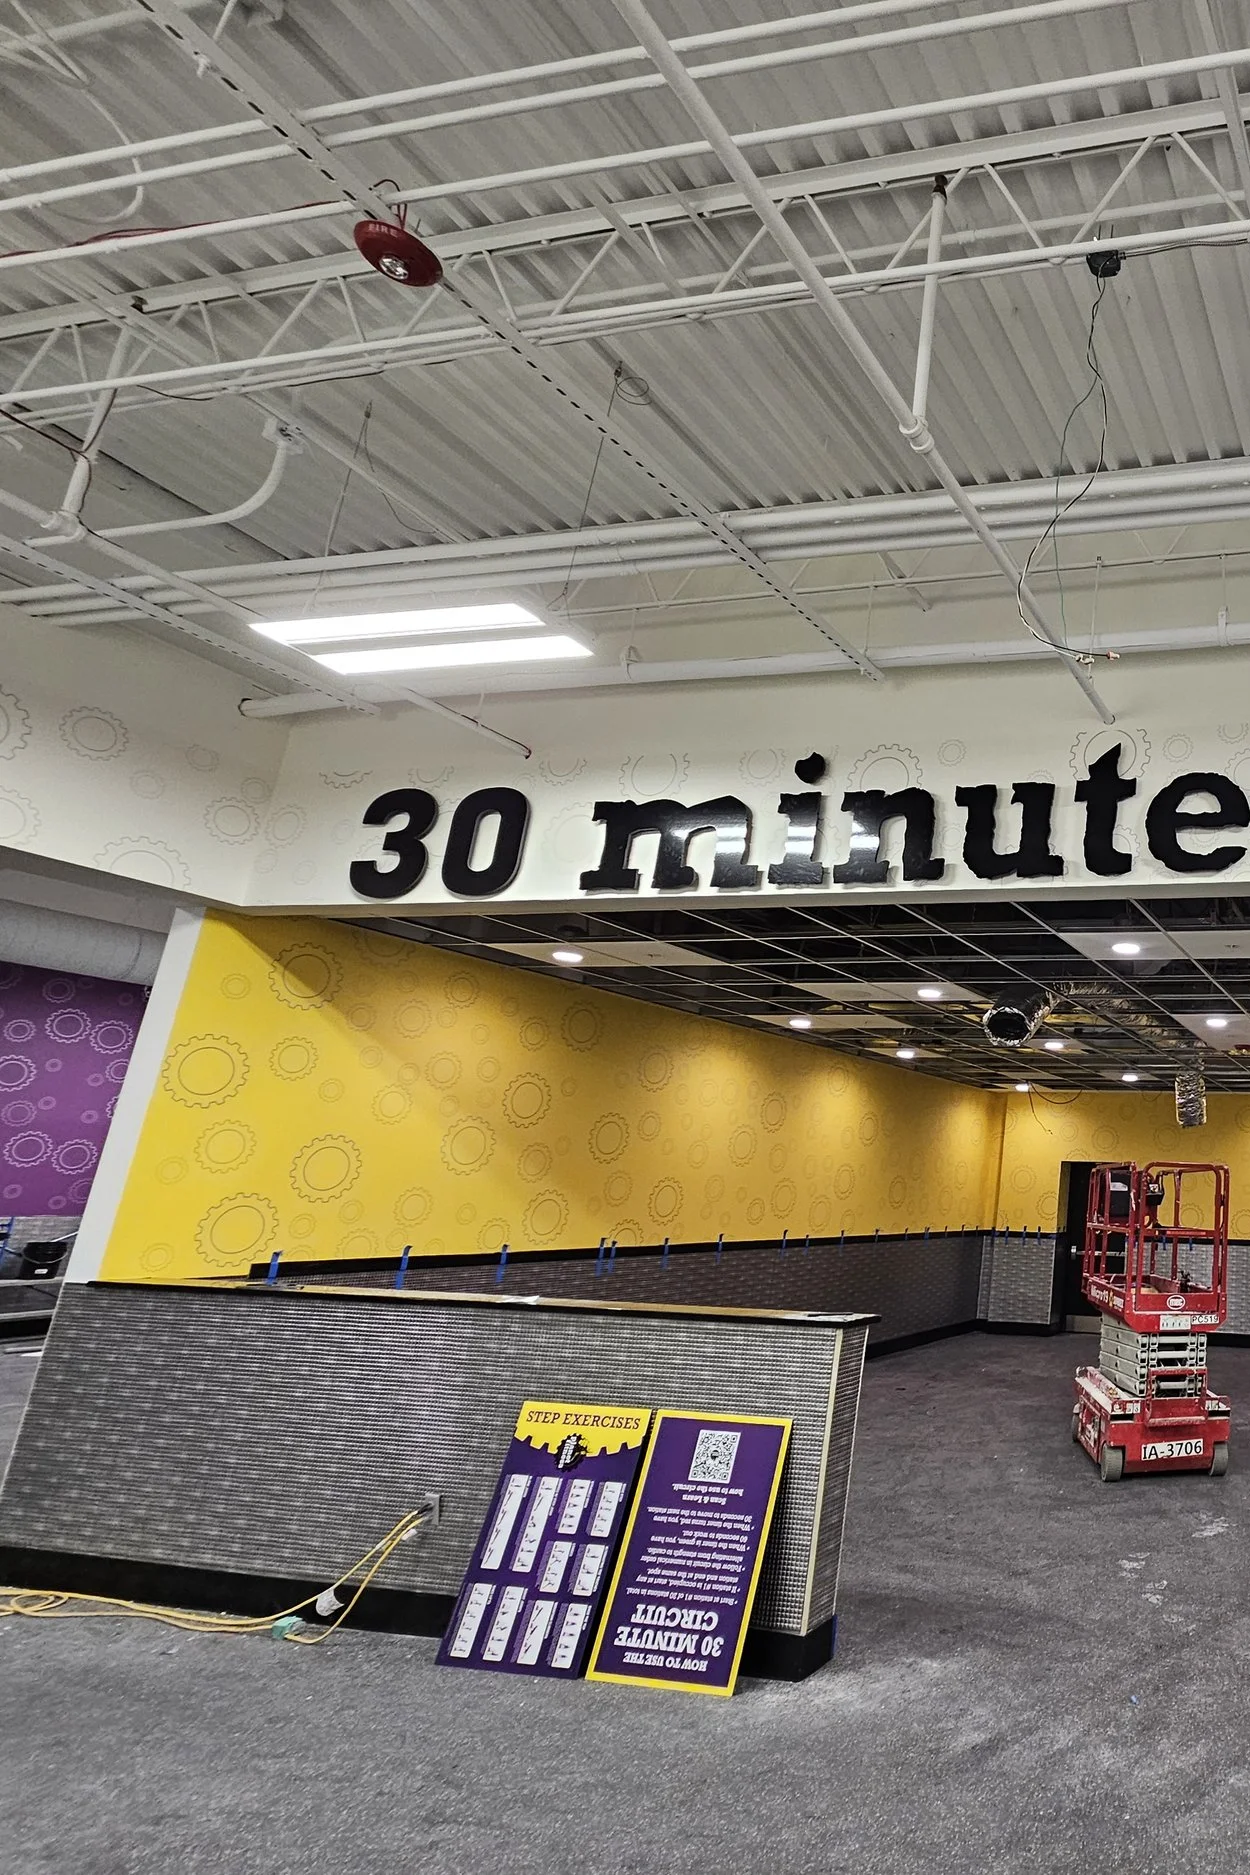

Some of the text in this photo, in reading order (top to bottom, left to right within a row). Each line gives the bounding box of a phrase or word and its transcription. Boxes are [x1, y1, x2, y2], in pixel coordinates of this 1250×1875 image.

[369, 223, 398, 238] FIRE
[350, 786, 531, 898] 30
[1192, 1314, 1219, 1324] PC519
[526, 1410, 642, 1430] STEP EXERCISES
[1142, 1440, 1202, 1460] IA-3706
[672, 1483, 696, 1491] circuit.
[729, 1488, 744, 1496] how
[682, 1494, 702, 1503] Learn
[710, 1497, 727, 1505] Scan
[653, 1515, 667, 1523] have
[707, 1520, 722, 1528] timer
[733, 1523, 750, 1531] When
[665, 1536, 677, 1544] you
[716, 1533, 740, 1541] seconds
[729, 1543, 745, 1551] When
[631, 1604, 719, 1631] CIRCUIT
[614, 1626, 724, 1657] 30 MINUTE
[623, 1652, 708, 1671] HOW TO USE THE
